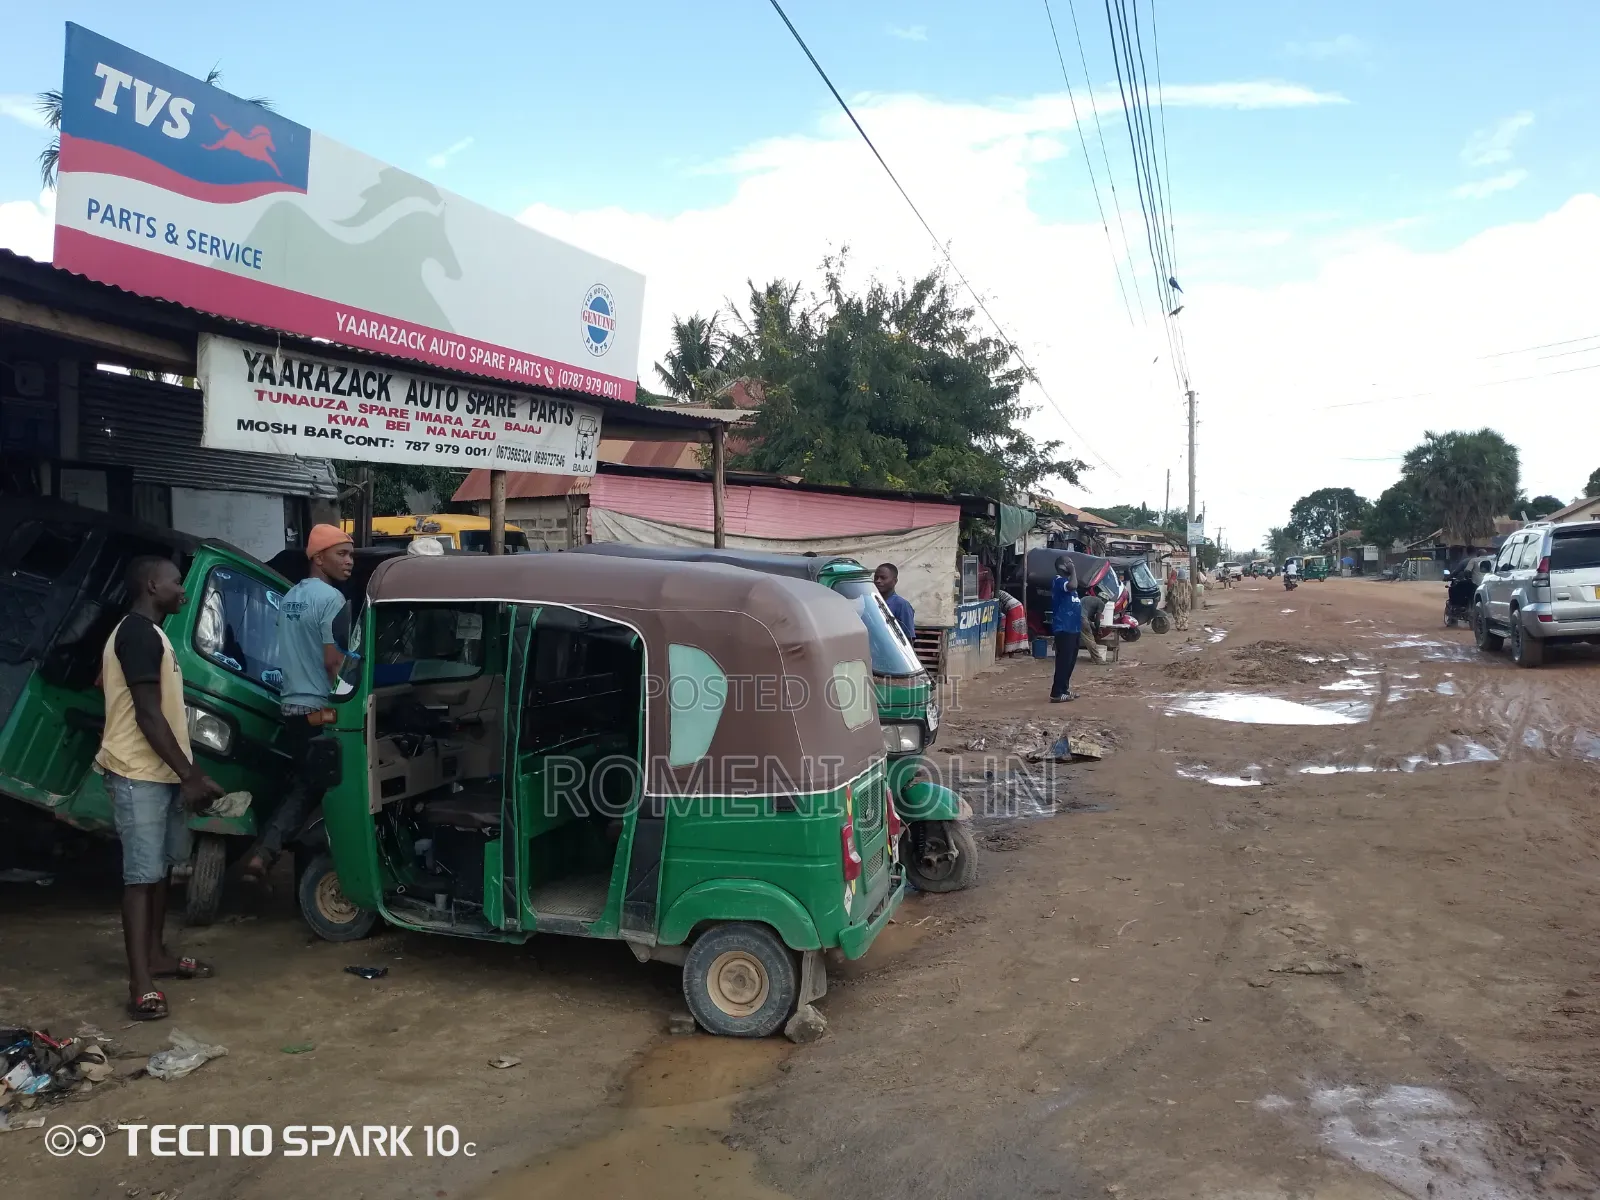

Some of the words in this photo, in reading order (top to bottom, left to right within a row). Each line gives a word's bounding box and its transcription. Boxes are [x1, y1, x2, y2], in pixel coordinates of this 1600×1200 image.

[94, 62, 195, 139] TVS
[87, 198, 157, 239] PARTS
[164, 222, 179, 246] &
[186, 229, 263, 270] SERVICE
[582, 309, 615, 331] GENUINE
[336, 311, 427, 352] YAARAZACK
[429, 336, 466, 361] AUTO
[469, 346, 505, 371] SPARE
[508, 357, 541, 380] PARTS
[586, 377, 601, 393] 979
[586, 336, 608, 354] PARTS
[242, 349, 393, 402] YAARAZACK
[405, 378, 459, 412] AUTO
[466, 389, 517, 419] SPARE
[529, 399, 575, 427] PARTS
[254, 389, 348, 412] TUNAUZA
[358, 403, 409, 420] SPARE
[415, 410, 463, 427] IMARA
[472, 418, 490, 429] ZA
[504, 421, 542, 435] BAJAJ
[327, 413, 370, 429] KWA
[385, 420, 410, 432] BEI
[426, 425, 447, 437] NA
[451, 428, 497, 441] NAFUU
[236, 418, 297, 436] MOSH
[404, 440, 430, 452] 787
[435, 443, 460, 455] 979
[572, 463, 593, 473] BAJAJ
